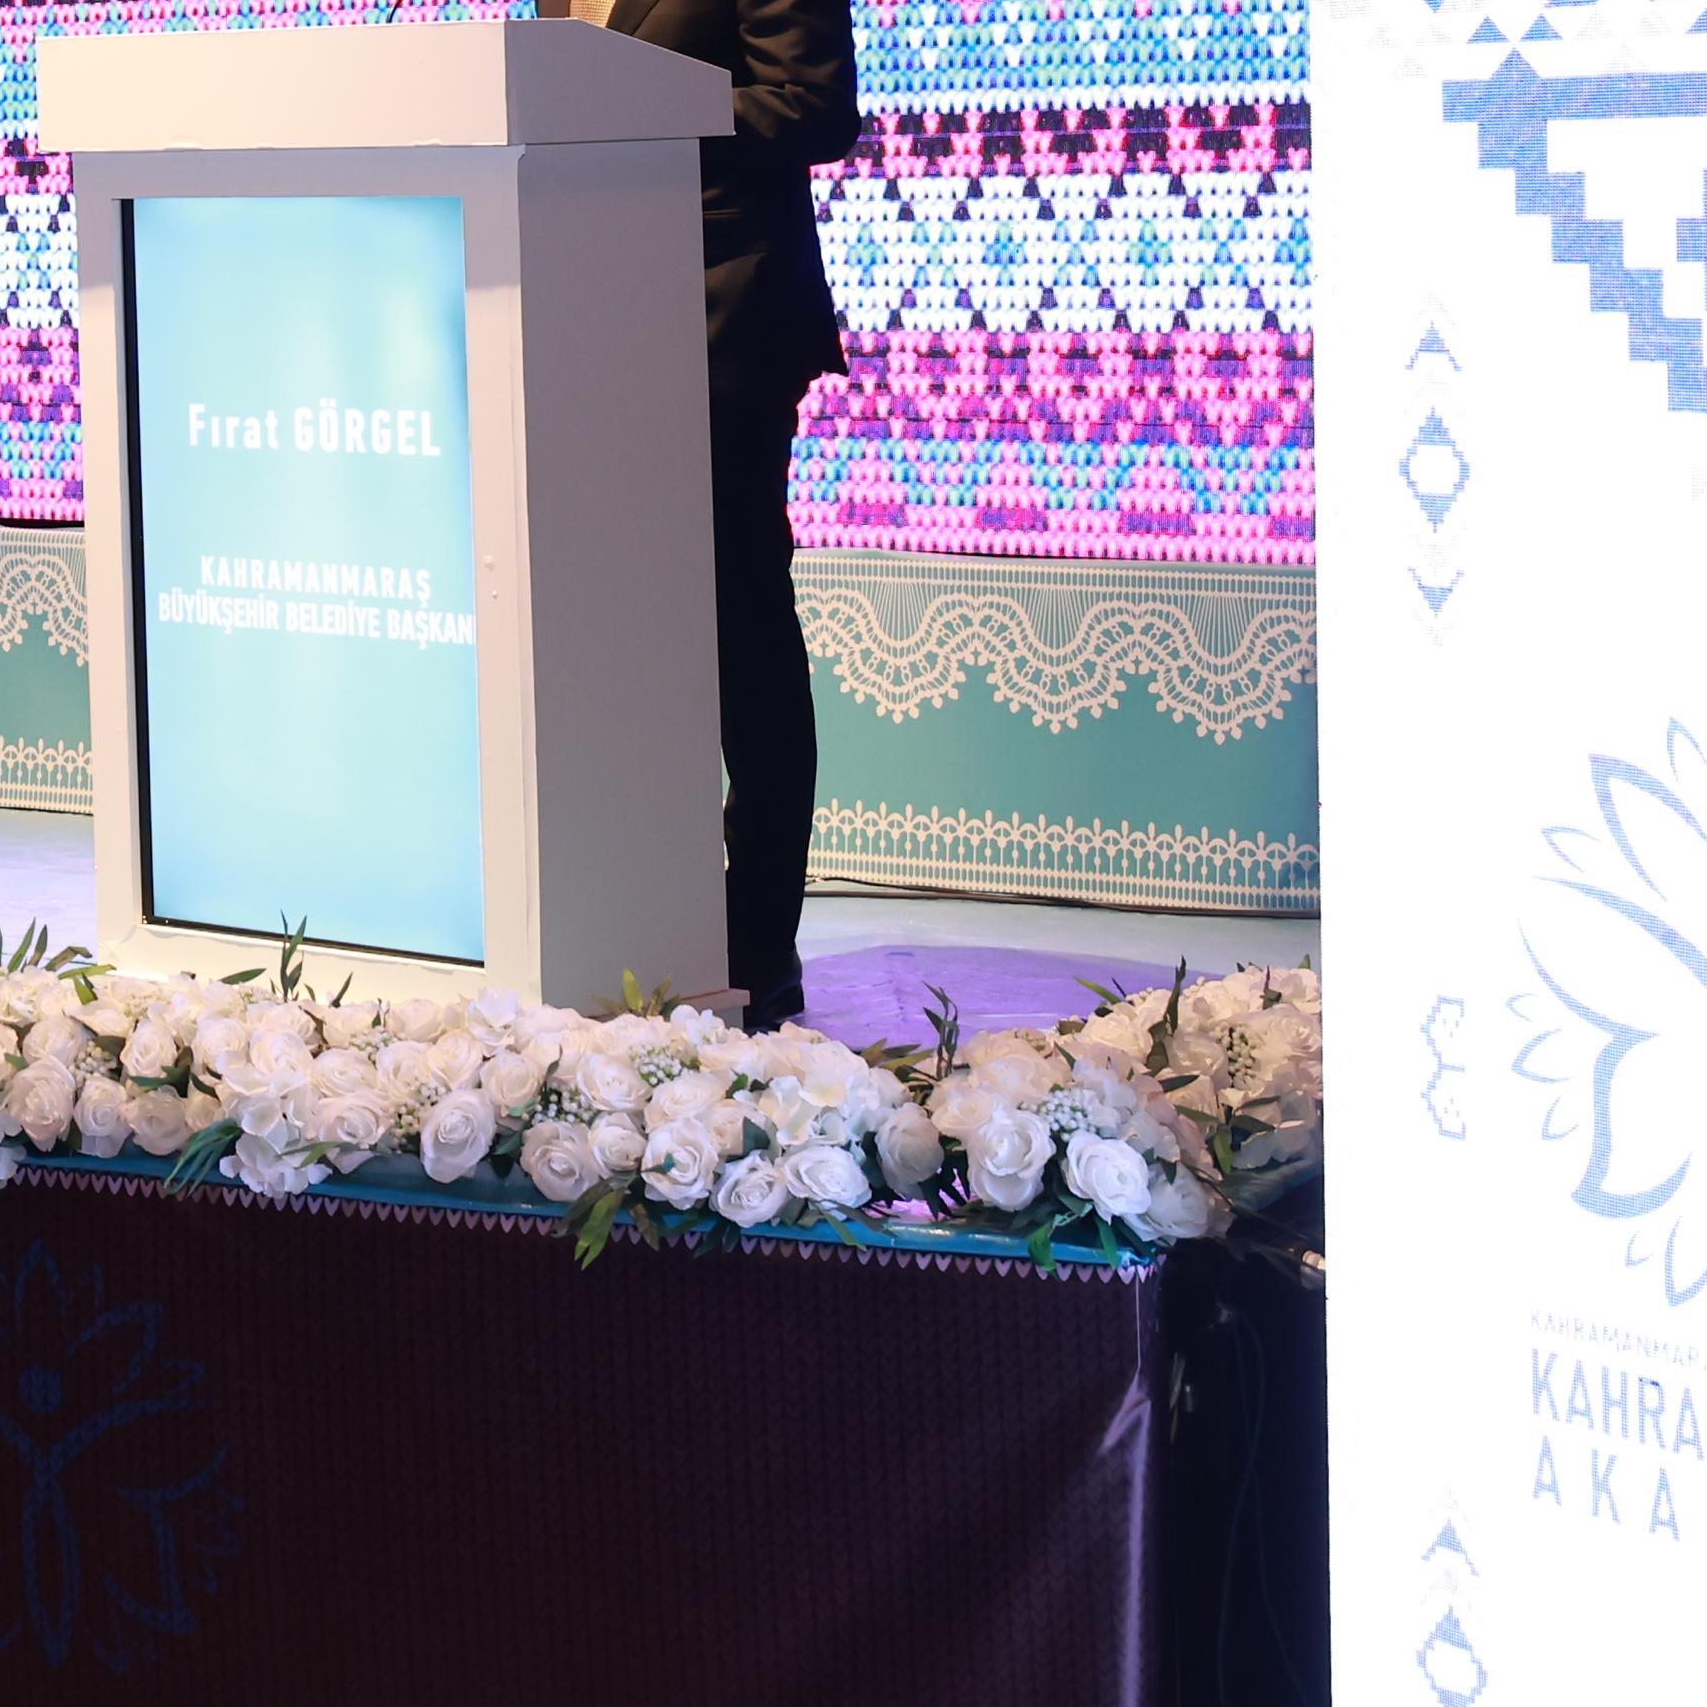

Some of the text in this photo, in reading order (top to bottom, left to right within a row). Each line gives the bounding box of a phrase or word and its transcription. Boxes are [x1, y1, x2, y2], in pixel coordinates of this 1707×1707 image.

[189, 398, 441, 457] Fırat GÖRGEL
[201, 555, 432, 609] KAHRAMANMARAŞ
[159, 588, 279, 635] BÜYÜKŞEHİR
[286, 600, 381, 638] BELEDİYE
